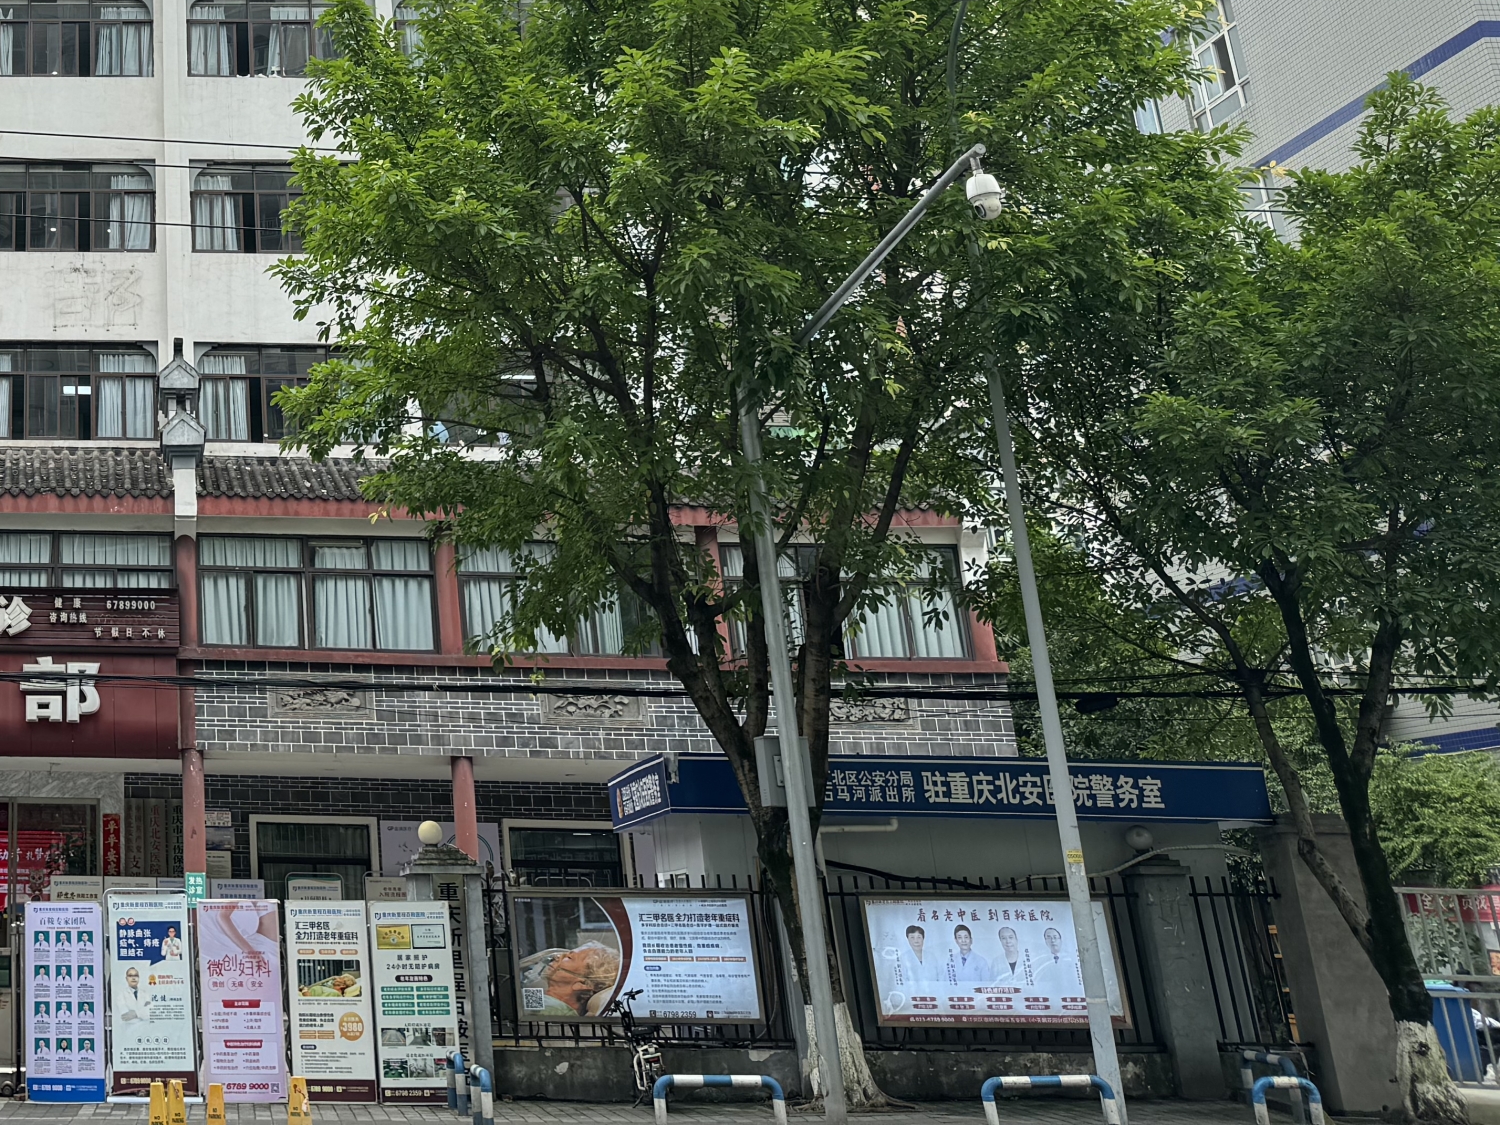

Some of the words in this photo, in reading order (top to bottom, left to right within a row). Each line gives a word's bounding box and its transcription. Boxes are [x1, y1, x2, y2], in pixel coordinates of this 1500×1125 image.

[54, 597, 82, 608] 健康
[106, 600, 156, 610] 67899000
[49, 612, 87, 623] 咨询热线
[94, 627, 166, 639] 节假日不休
[827, 770, 914, 787] 北区公安分局
[639, 913, 675, 922] 汇三甲名医
[675, 913, 740, 923] 全力打造老年重症科
[917, 908, 981, 922] 看名老中医
[988, 909, 1054, 922] 到百鞍医院
[295, 921, 330, 930] 汇三甲名医
[119, 929, 152, 938] 静脉曲张
[295, 931, 359, 941] 全力打造老年重症科
[119, 948, 144, 957] 胆结石
[207, 954, 272, 977] 微创妇科
[680, 1010, 697, 1018] 2359
